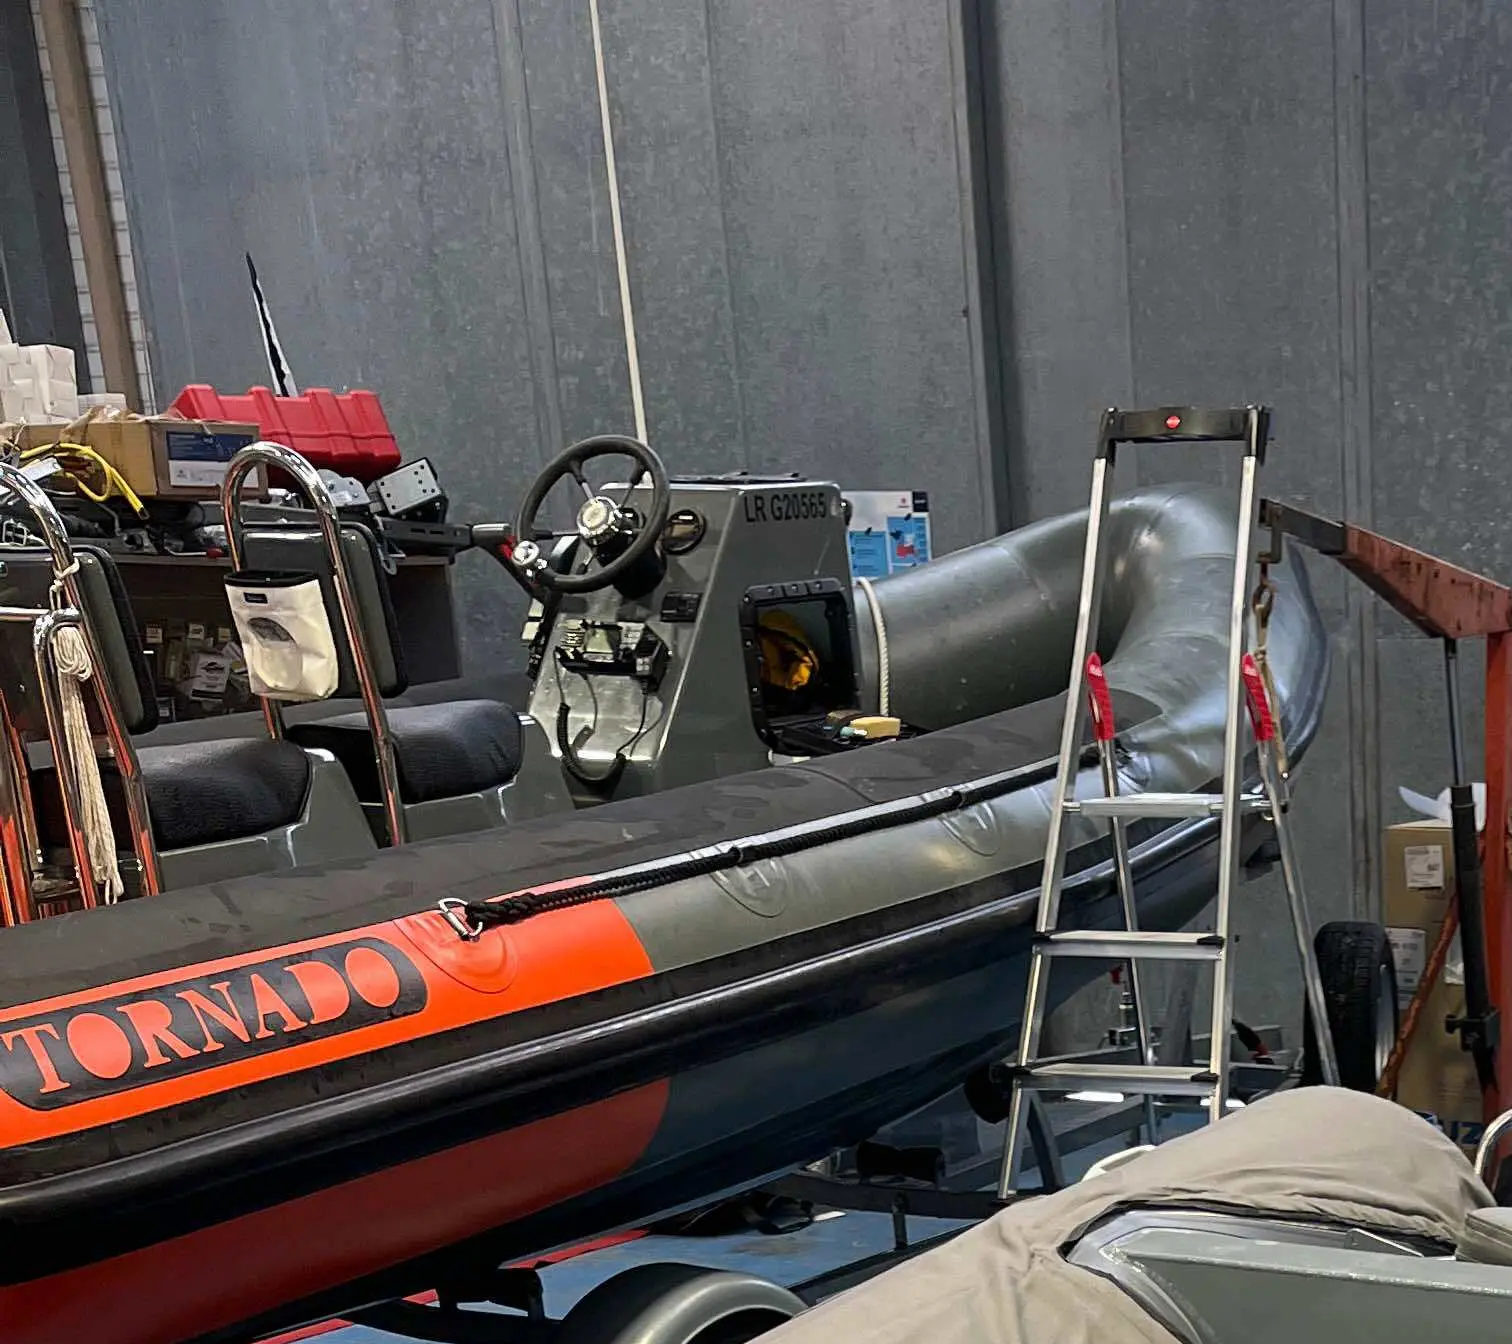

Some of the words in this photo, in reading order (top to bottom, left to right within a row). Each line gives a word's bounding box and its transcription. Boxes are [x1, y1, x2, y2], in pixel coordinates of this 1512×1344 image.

[743, 496, 767, 523] LR
[771, 492, 828, 522] G20565
[1, 946, 401, 1095] TORNADO
